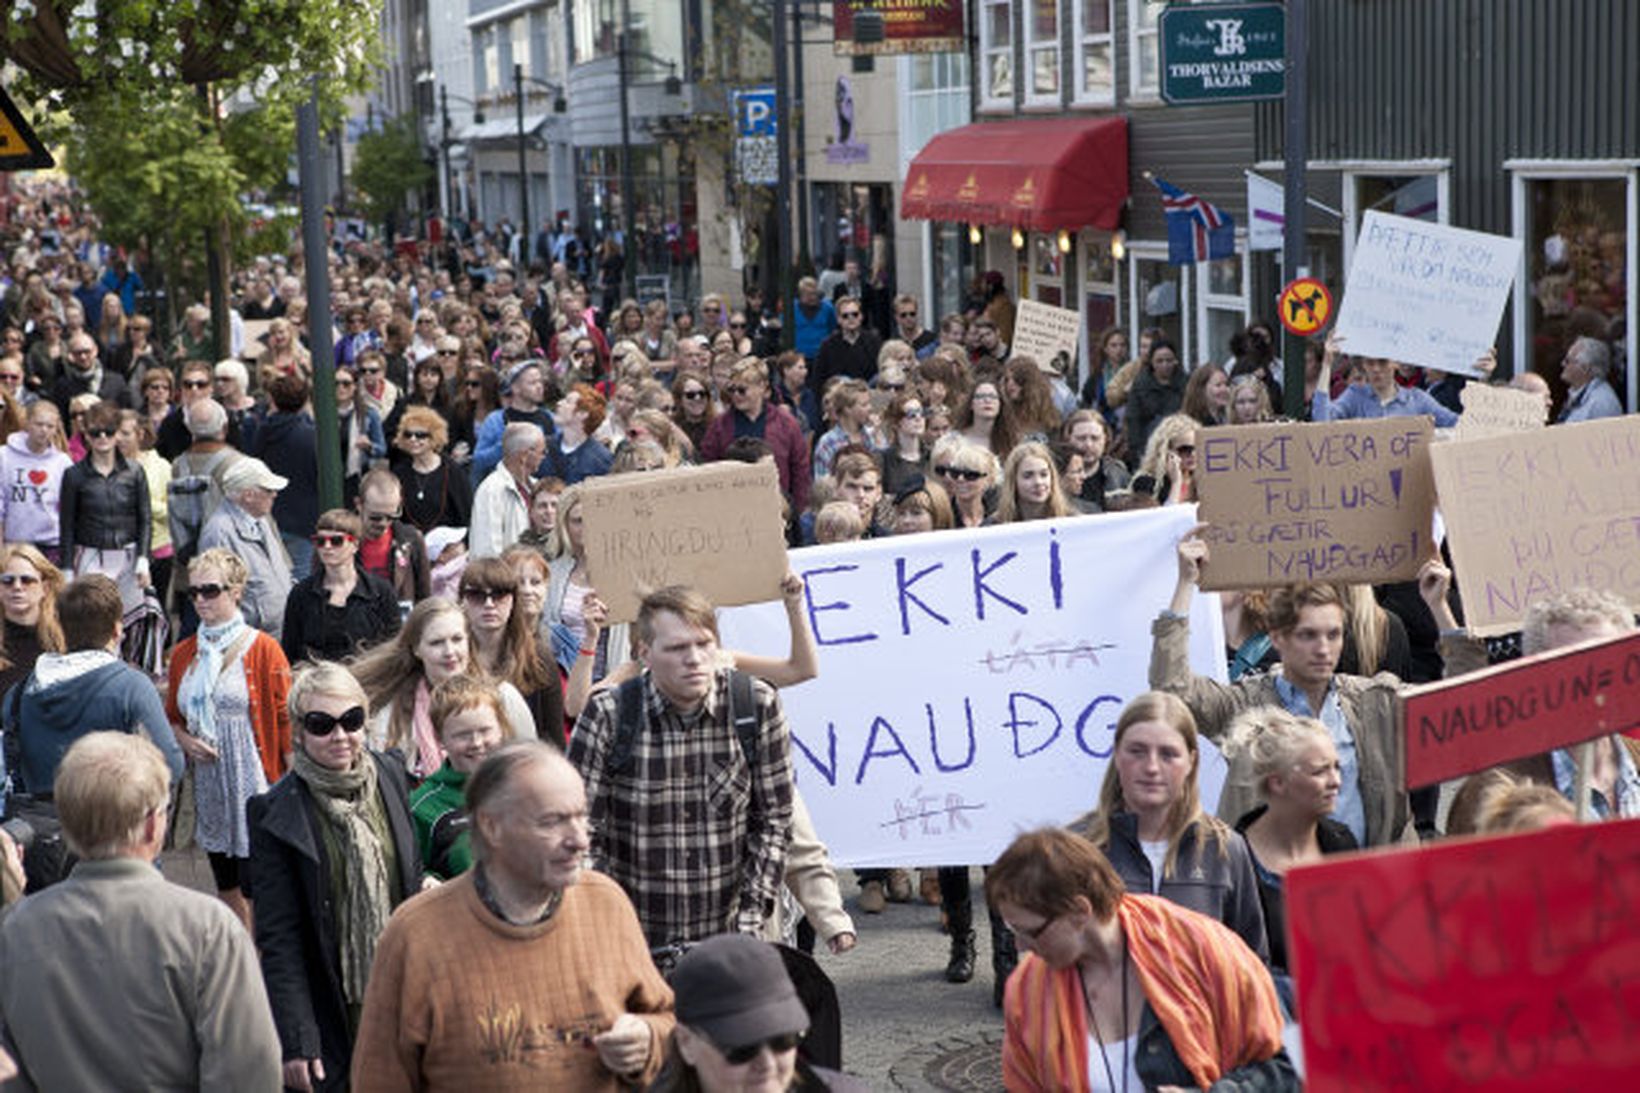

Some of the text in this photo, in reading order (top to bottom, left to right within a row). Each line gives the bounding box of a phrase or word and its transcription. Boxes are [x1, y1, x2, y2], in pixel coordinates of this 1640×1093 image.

[1169, 60, 1285, 78] THORVALDSENS
[1203, 74, 1252, 89] BAZAR
[748, 101, 769, 129] P
[1205, 432, 1424, 472] EKKI VERA OF
[15, 467, 26, 484] I
[9, 485, 49, 503] NY
